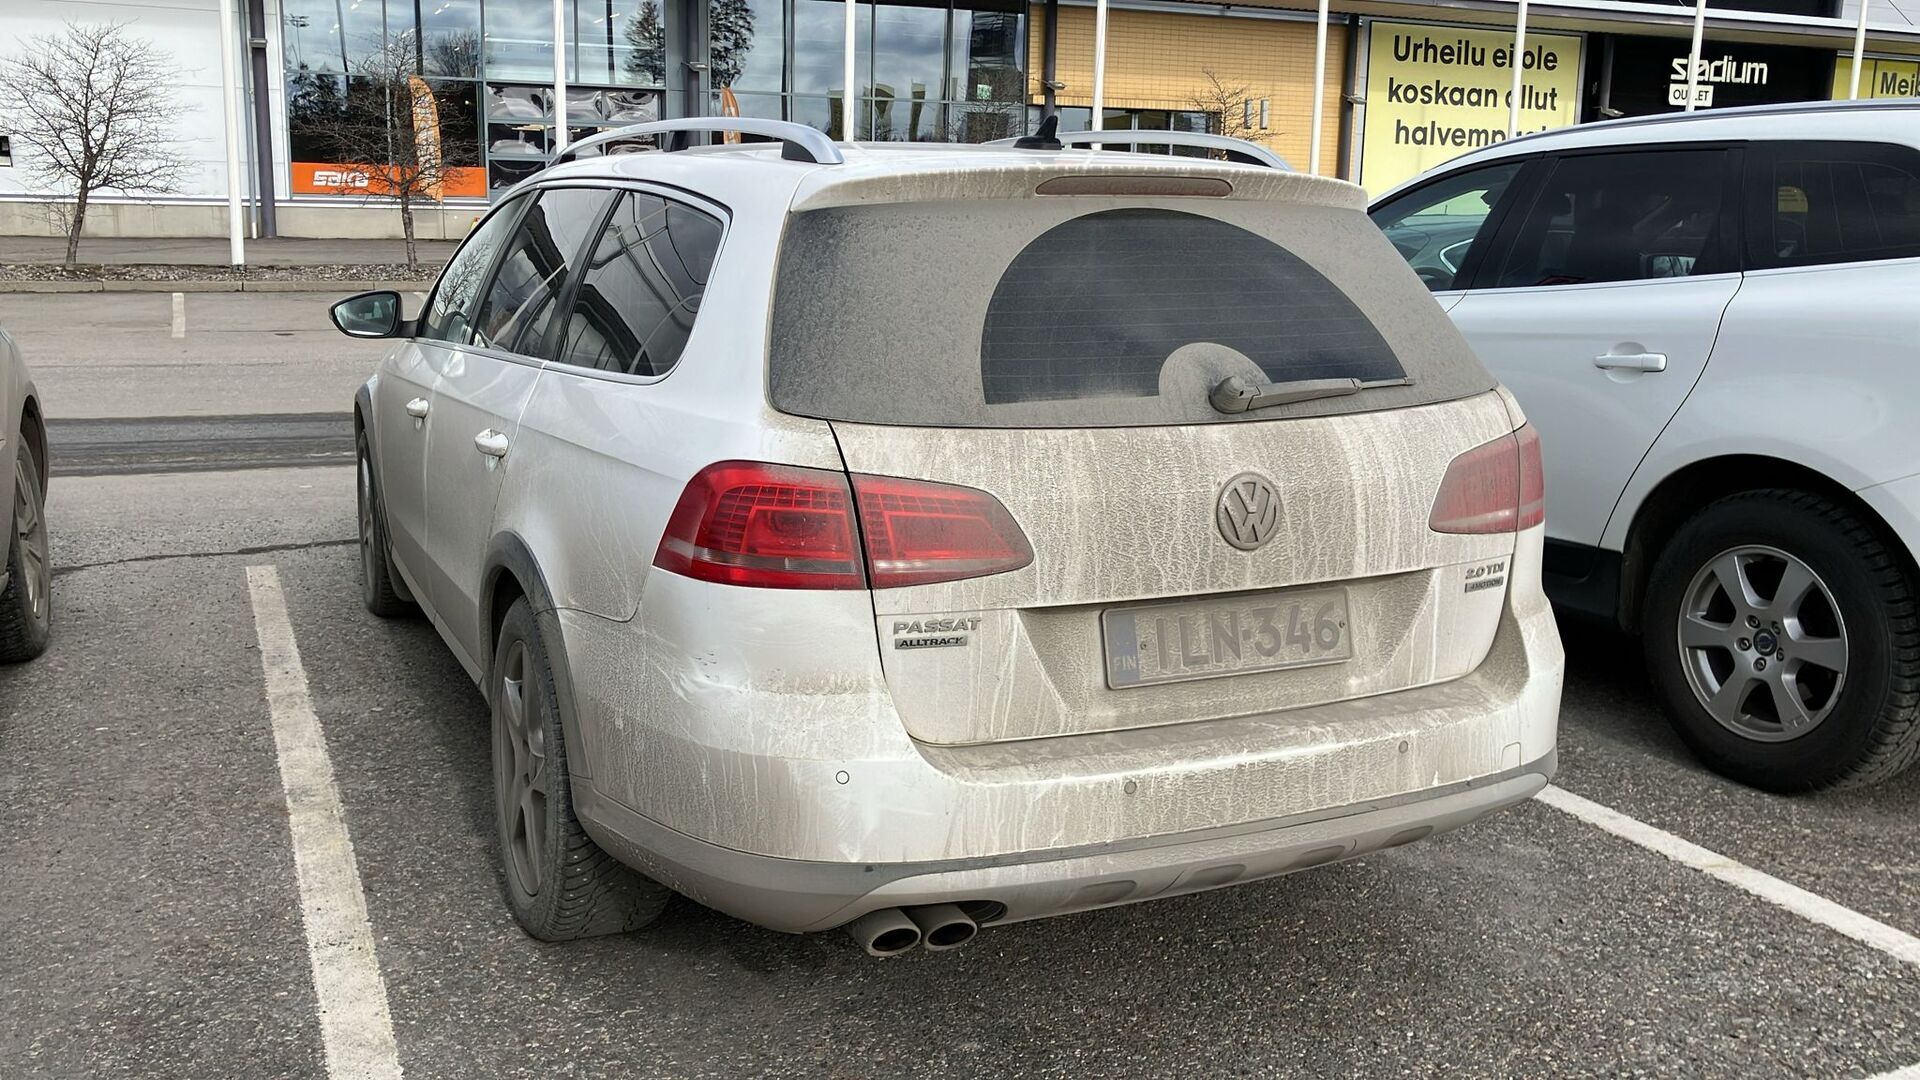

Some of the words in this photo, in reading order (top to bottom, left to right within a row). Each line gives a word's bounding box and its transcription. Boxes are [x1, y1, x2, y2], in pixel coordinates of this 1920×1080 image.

[1393, 35, 1485, 66] Urheilu
[1492, 43, 1514, 68] ei
[1522, 45, 1558, 71] ole
[1387, 77, 1498, 108] koskaan
[1880, 71, 1920, 97] Mei
[1672, 88, 1710, 102] OUET
[1486, 561, 1505, 576] TDI
[893, 617, 981, 635] PASSAT
[899, 636, 964, 648] ALLTRACK
[1155, 601, 1341, 672] ILN-346
[1113, 655, 1138, 672] FIN
